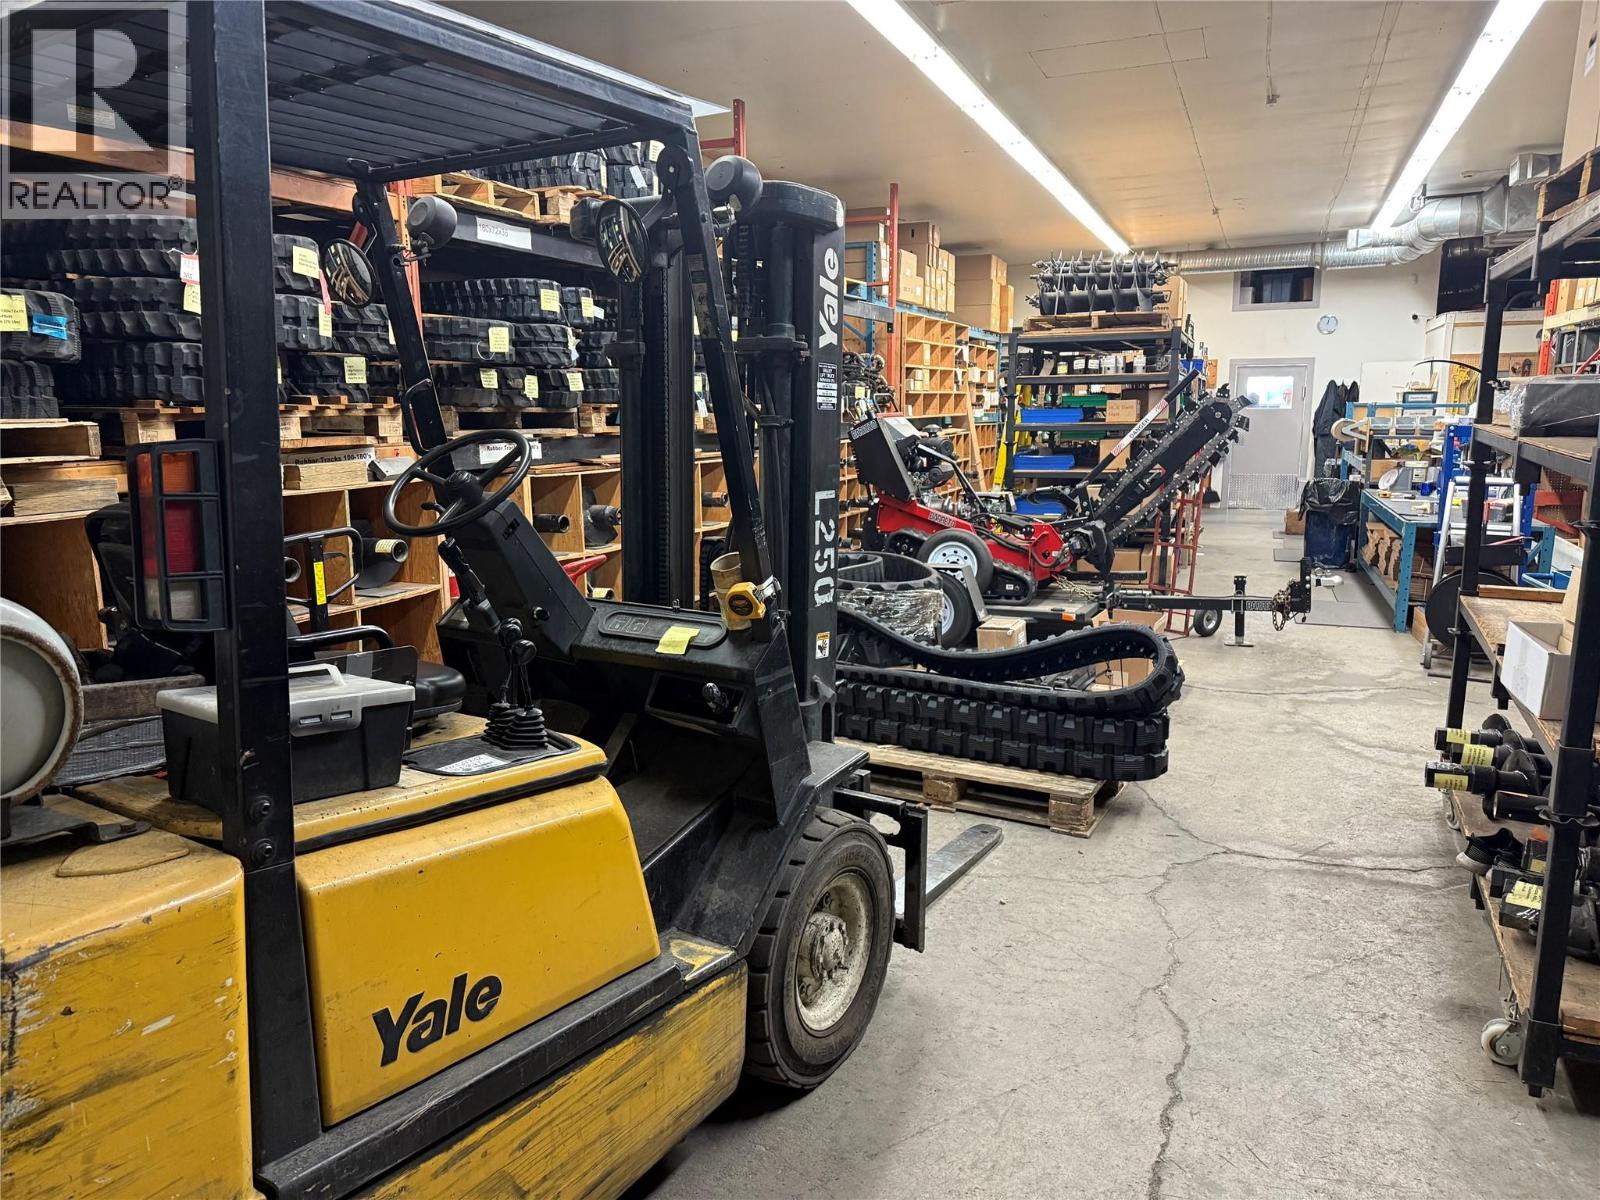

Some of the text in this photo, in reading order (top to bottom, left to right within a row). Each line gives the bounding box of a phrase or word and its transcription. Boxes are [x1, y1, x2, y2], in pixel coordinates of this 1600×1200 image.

[818, 247, 840, 349] Yale
[294, 457, 319, 465] Rubber
[320, 455, 341, 463] Tracks
[1129, 418, 1150, 439] DANGER
[814, 489, 836, 607] L250
[371, 972, 503, 1067] Yale
